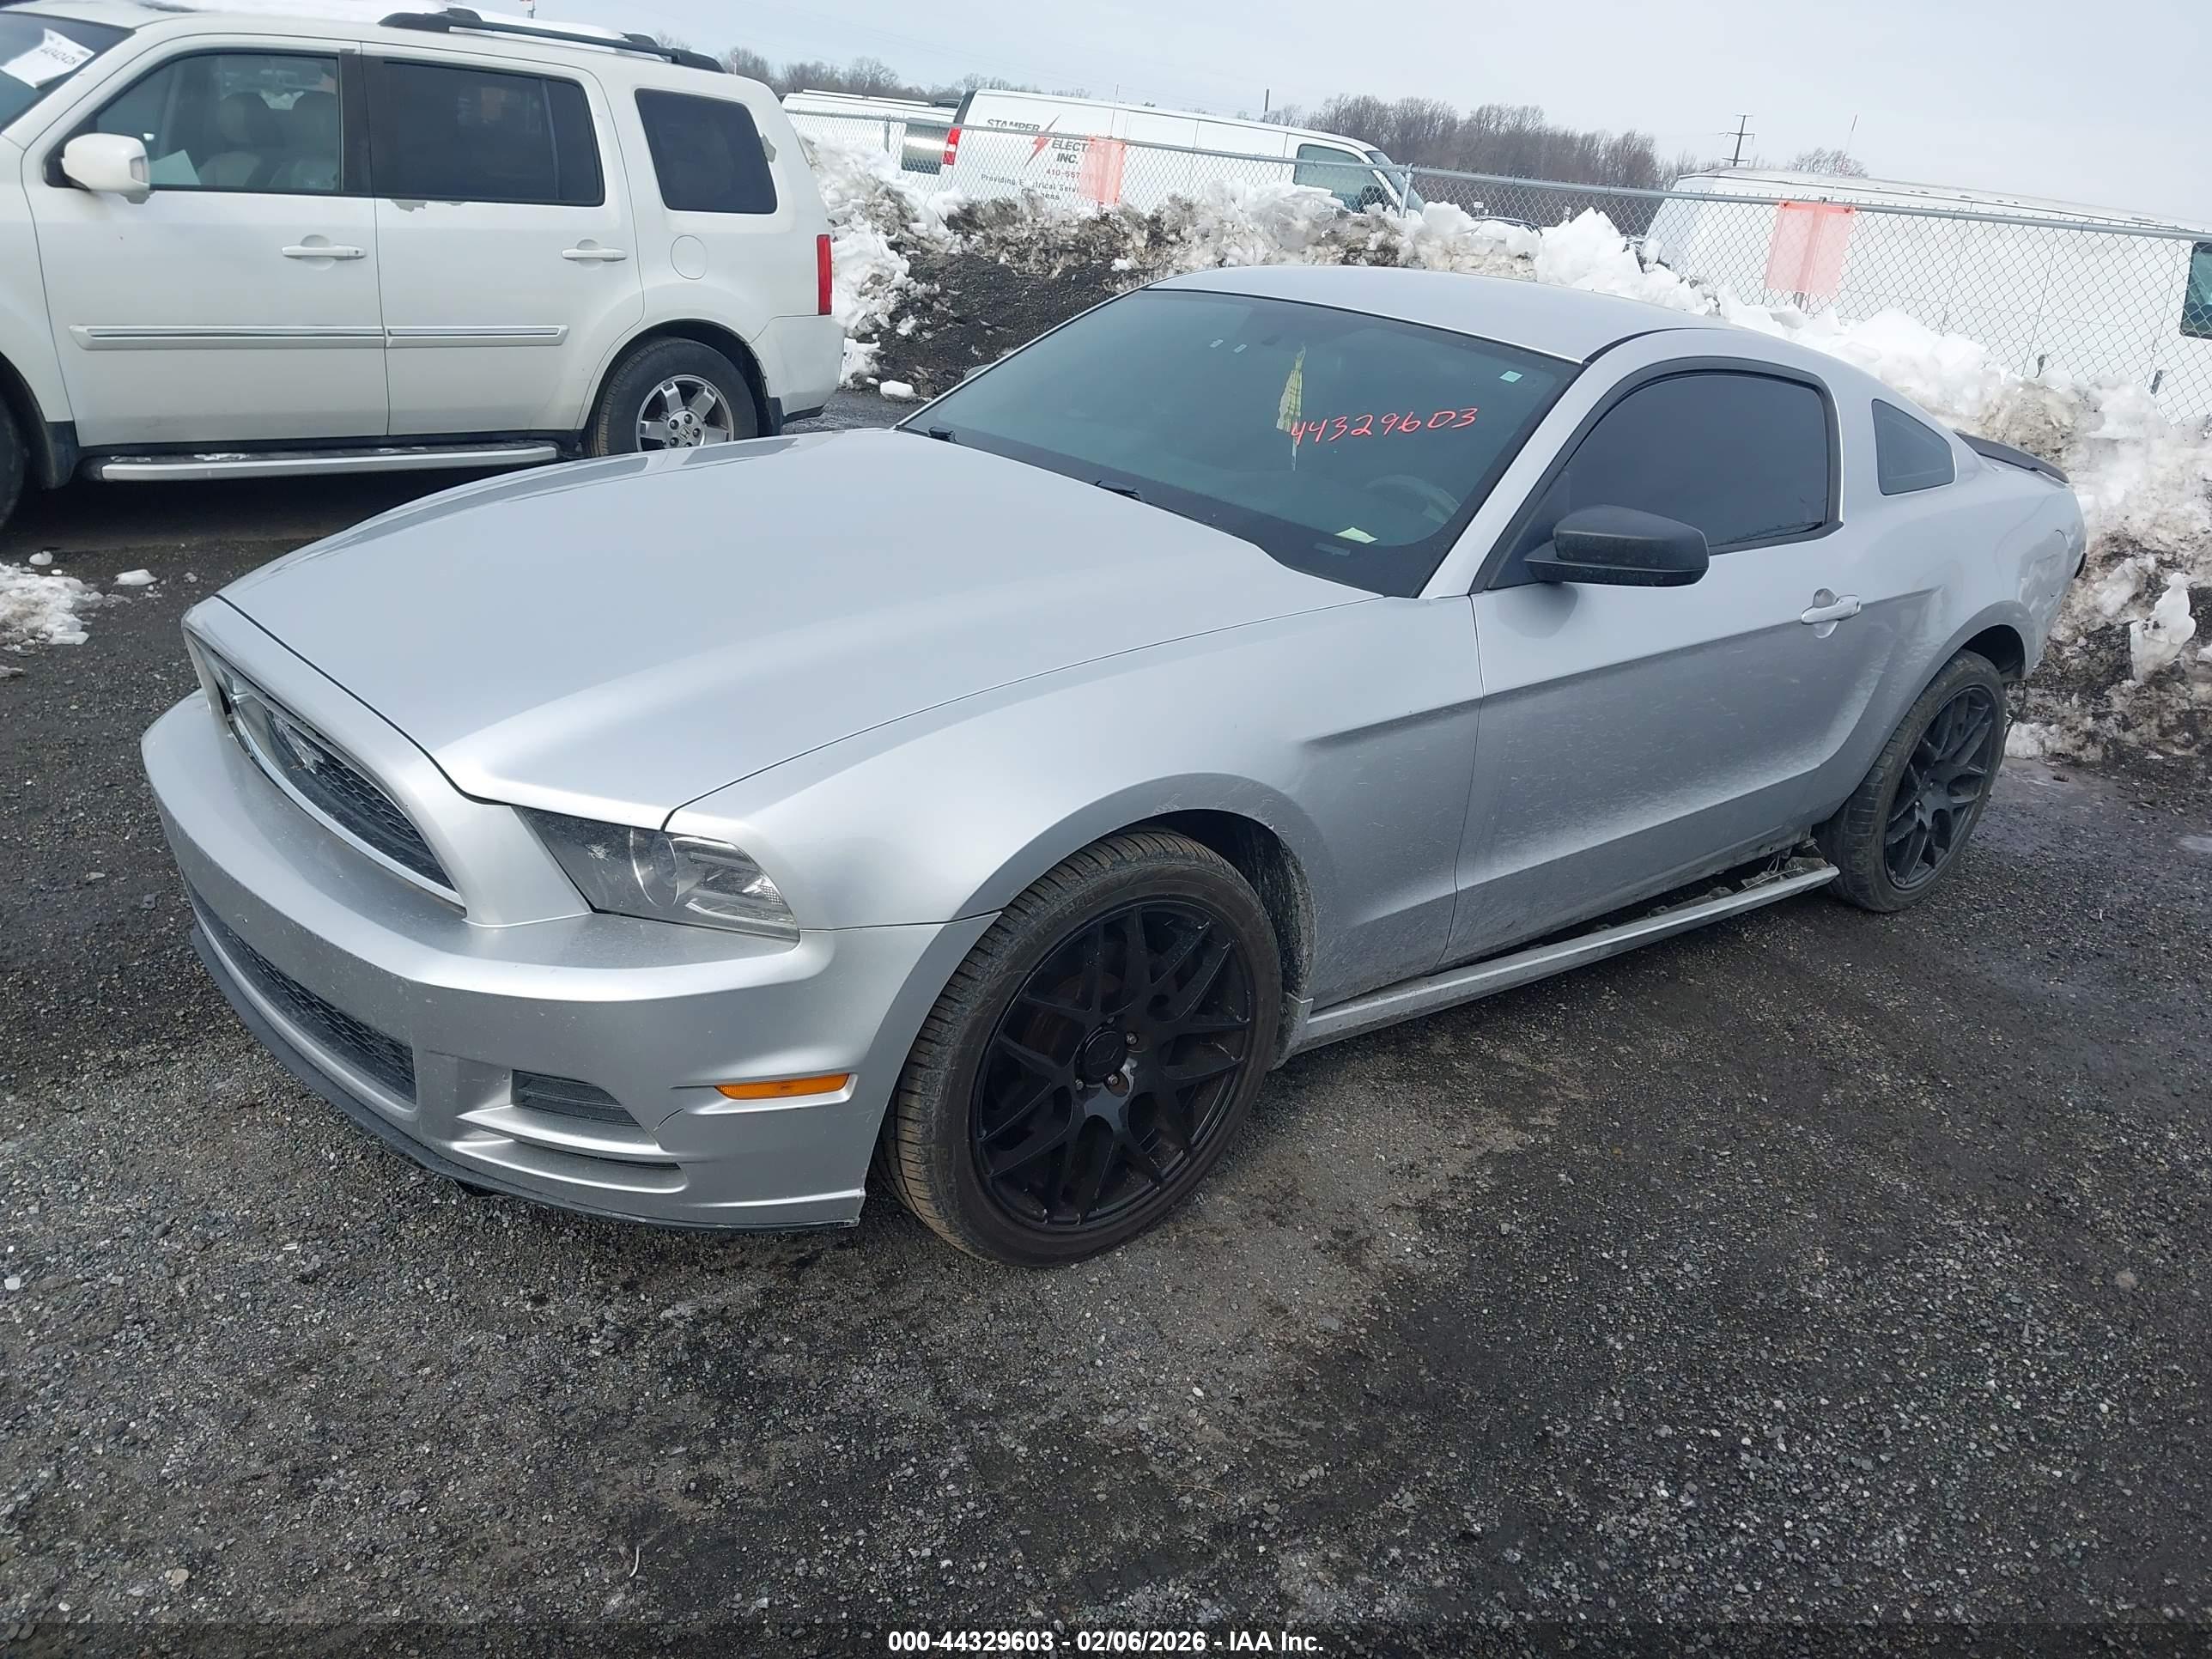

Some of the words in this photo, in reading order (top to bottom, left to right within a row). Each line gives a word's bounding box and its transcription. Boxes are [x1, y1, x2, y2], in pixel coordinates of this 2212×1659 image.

[987, 118, 1041, 132] STAMPER
[1056, 153, 1079, 165] INC.
[1291, 406, 1479, 446] 44329603
